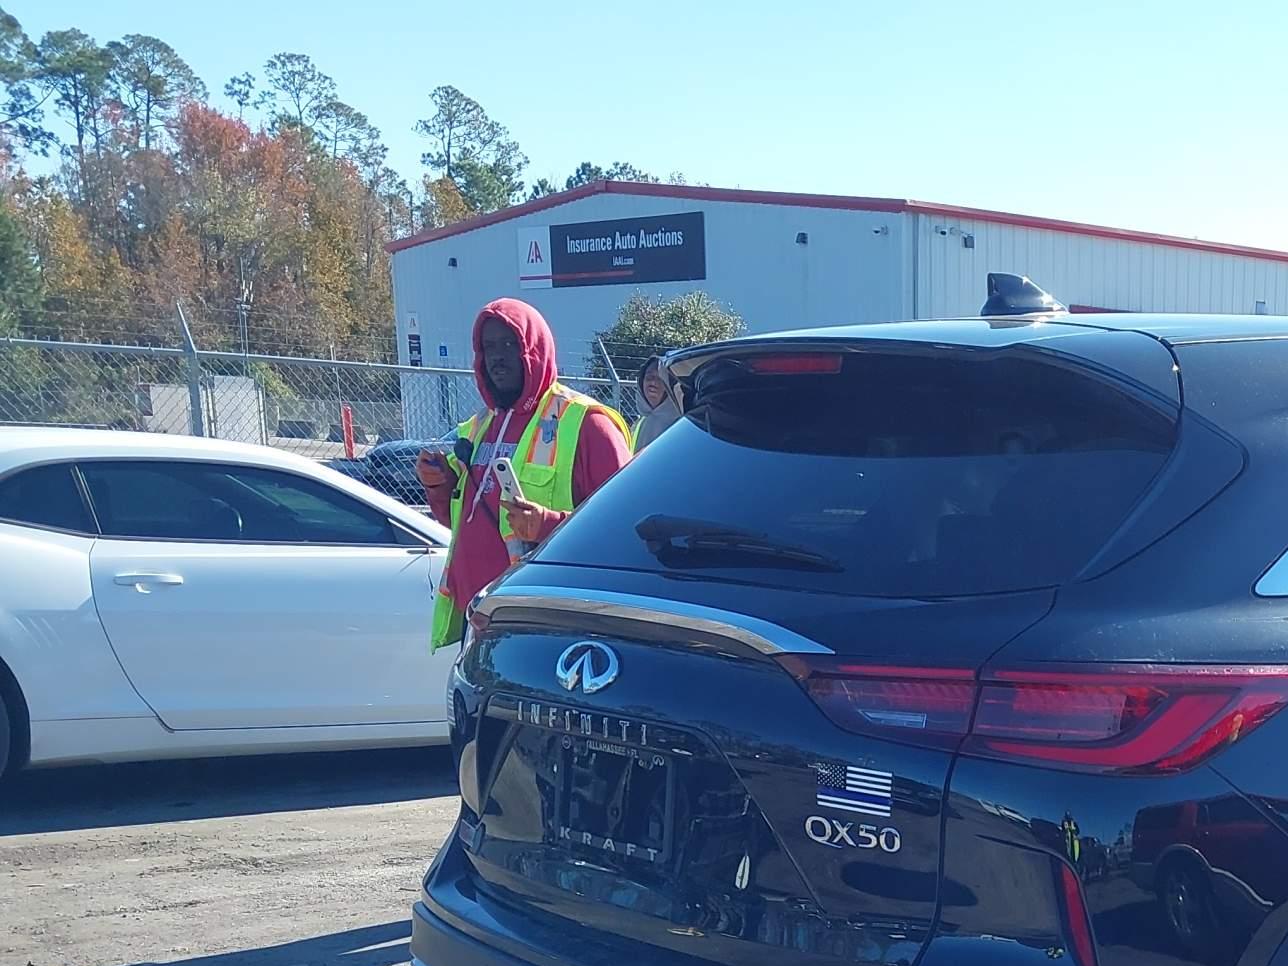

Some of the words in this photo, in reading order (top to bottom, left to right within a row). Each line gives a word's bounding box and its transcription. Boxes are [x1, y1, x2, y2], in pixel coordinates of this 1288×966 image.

[567, 235, 612, 253] Insurance
[614, 231, 637, 250] Auto
[638, 227, 684, 248] Auctions
[517, 700, 648, 746] INFINITI
[559, 825, 658, 862] KRAFT
[804, 815, 901, 854] QX50
